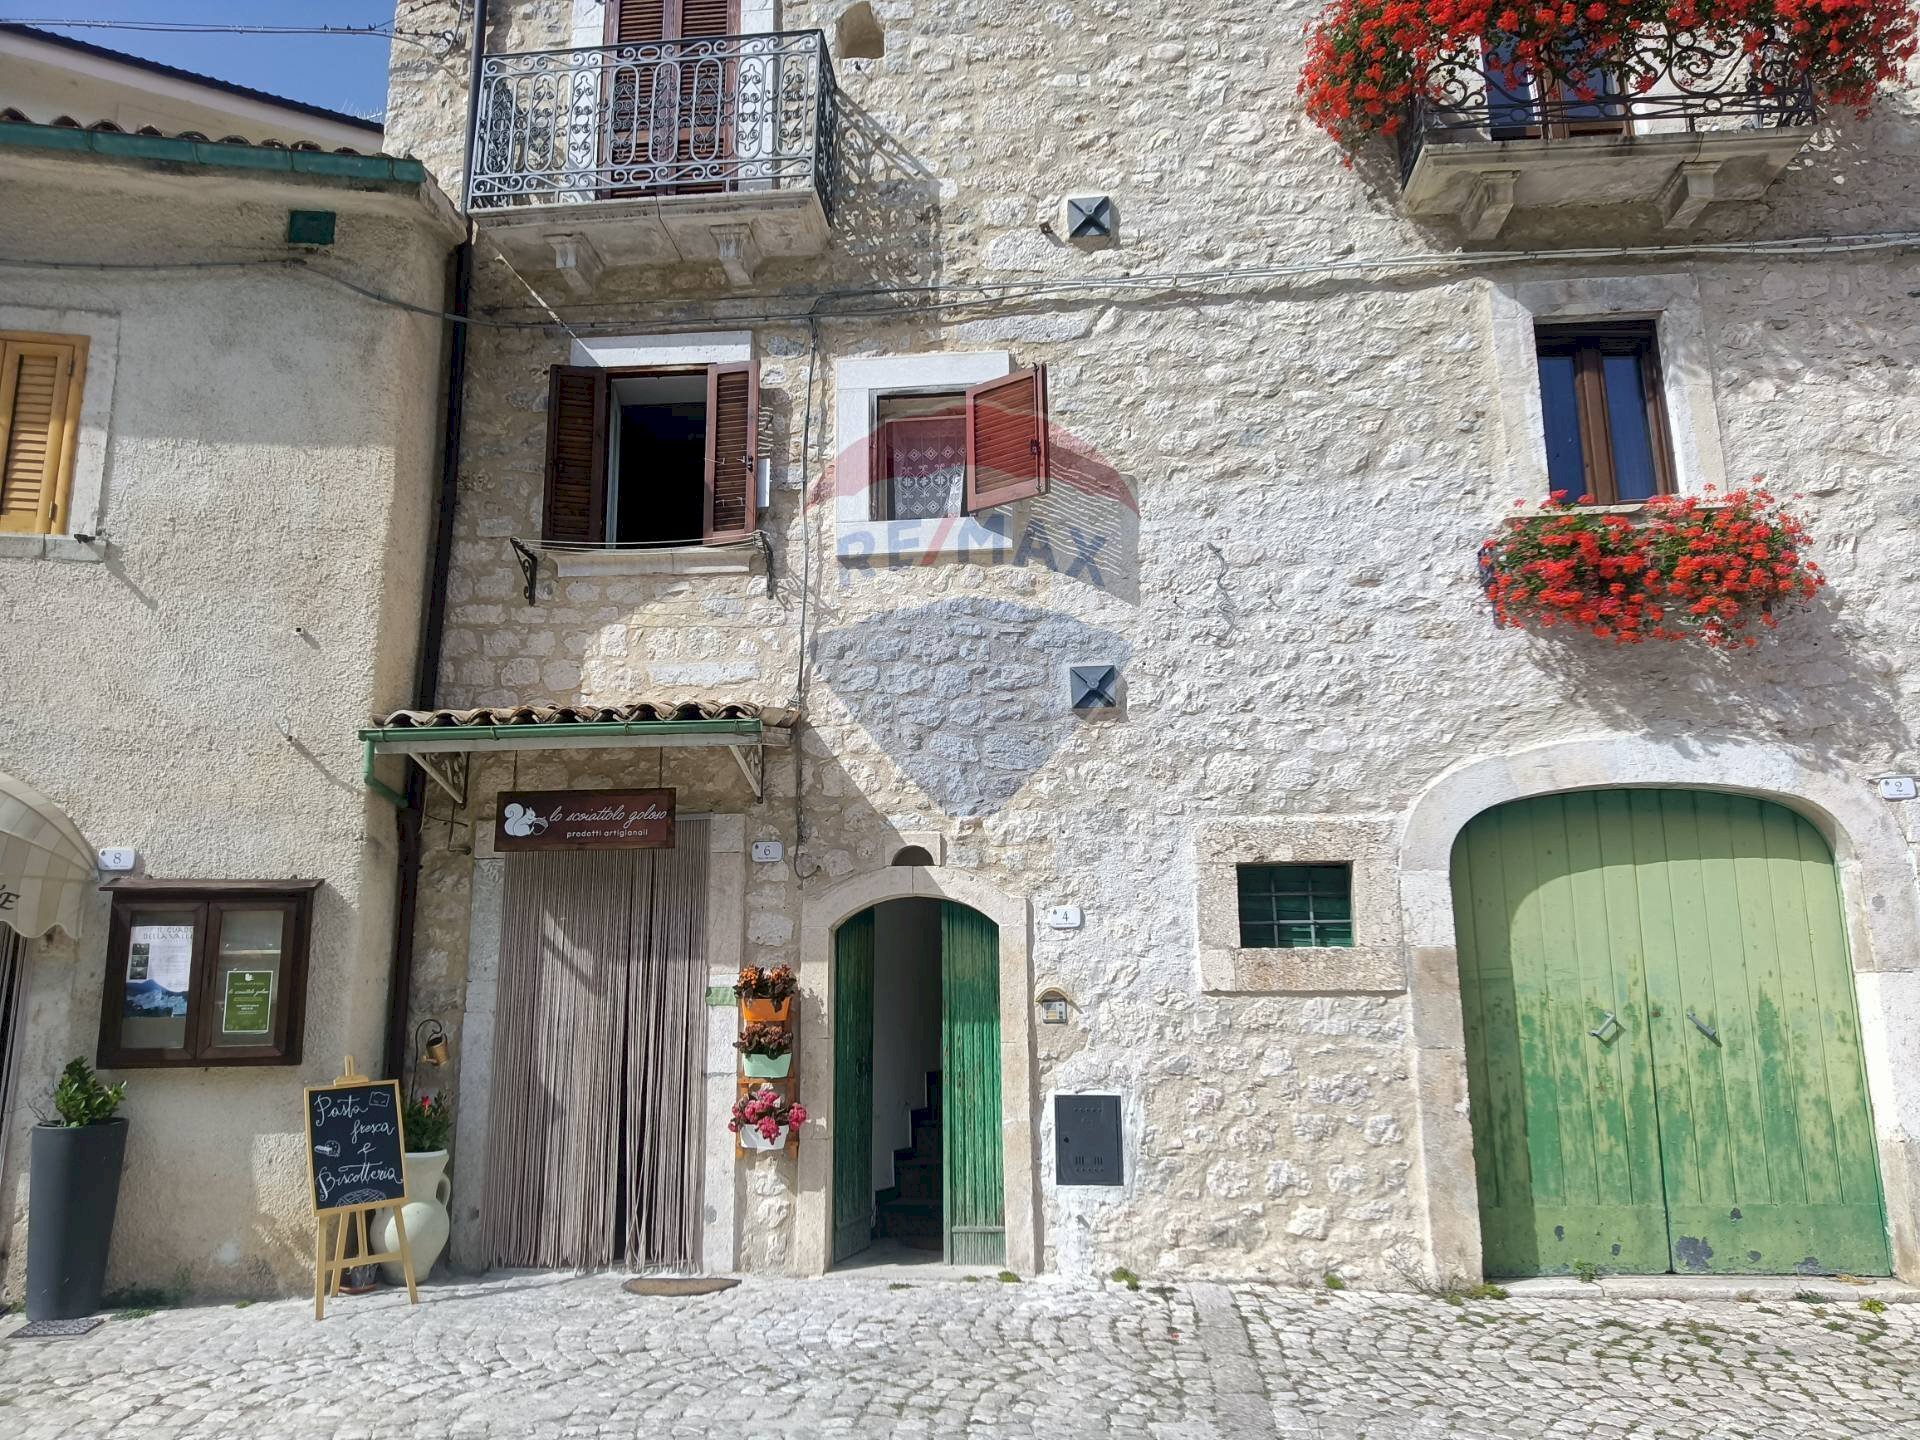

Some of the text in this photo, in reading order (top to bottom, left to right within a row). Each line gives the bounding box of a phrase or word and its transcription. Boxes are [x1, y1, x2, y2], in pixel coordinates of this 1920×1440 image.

[1894, 781, 1904, 793] 2
[549, 803, 668, 829] lo scoiattolo goloso
[566, 828, 648, 839] prodotti artigianali
[763, 845, 771, 856] 6
[112, 852, 122, 865] 8
[1062, 910, 1070, 922] 4
[314, 1094, 369, 1127] Pasta
[350, 1119, 395, 1144] fresca
[315, 1161, 404, 1202] Biscotteria
